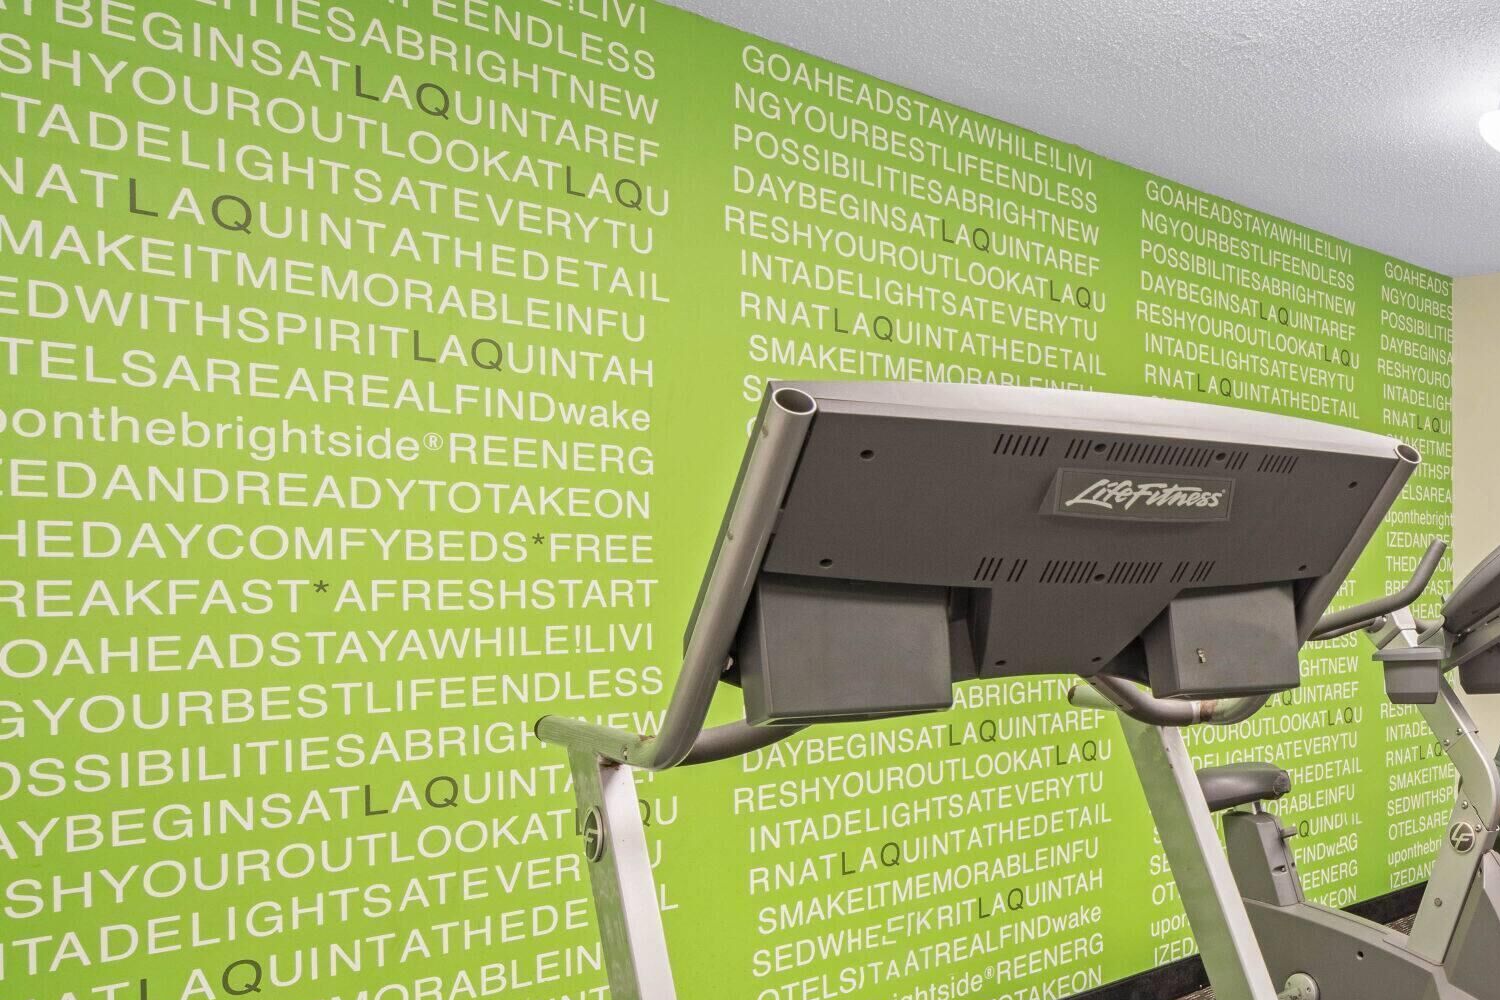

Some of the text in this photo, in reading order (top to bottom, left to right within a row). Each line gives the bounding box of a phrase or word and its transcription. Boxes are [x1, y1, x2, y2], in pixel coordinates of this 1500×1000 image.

[734, 83, 1098, 213] NGYOURBESTLIFEENDLESS
[741, 45, 1093, 180] GOAHEADSTAYAWHILE!LIVI
[0, 92, 653, 254] TADELIGHTSATEVERYTU
[733, 124, 1100, 246] POSSIBILITIESABRIGHTNEW
[724, 205, 1106, 313] RESHYOUROUTLOOKATLAQU
[733, 166, 1100, 278] DAYBEGINSATLAQUINTAREF
[1141, 209, 1355, 292] NGYOURBESTLIFEENDLESS
[1146, 180, 1352, 265] GOAHEADSTAYAWHILE!LIVI
[741, 250, 1098, 341] INTADELIGHTSATEVERYTU
[1141, 240, 1356, 317] POSSIBILITIESABRIGHTNEW
[1141, 271, 1356, 341] DAYBEGINSATLAQUINTAREF
[740, 292, 1106, 376] RNATLAQUINTATHEDETAIL
[1136, 301, 1360, 370] RESHYOUROUTLOOKATLAQU
[1145, 333, 1354, 393] INTADELIGHTSATEVERYTU
[1144, 364, 1360, 419] RNATLAQUINTATHEDETAIL
[0, 459, 650, 519] EDANDREADYTOTAKEON
[0, 623, 654, 679] OAHEADSTAYAWHILE!LIVI
[733, 738, 1112, 815] RESHYOUROUTLOOKATLAQU
[750, 770, 1103, 853] INTADELIGHTSATEVERYTU
[750, 802, 1112, 895] RNATLAQUINTATHEDETAIL
